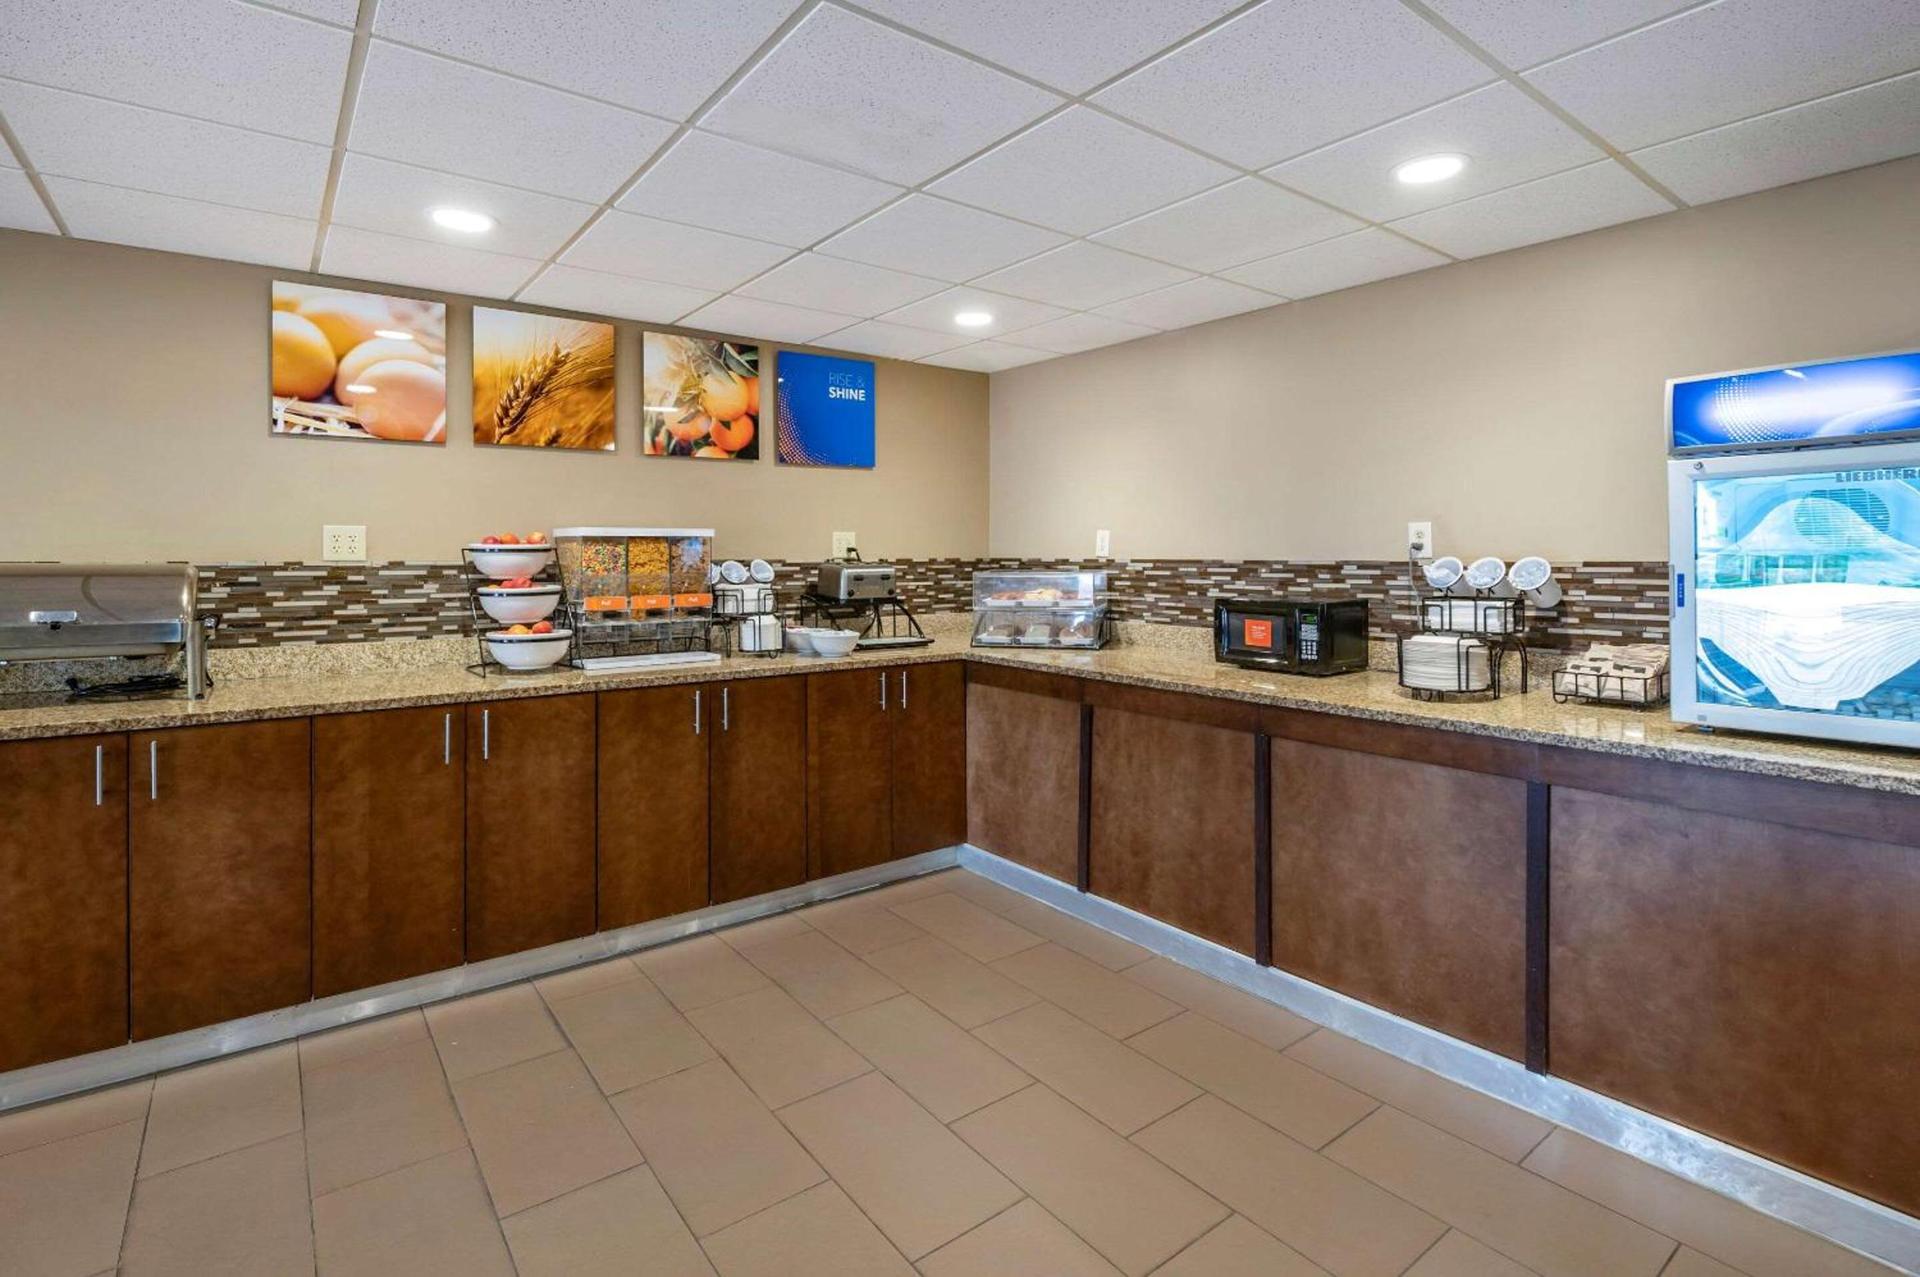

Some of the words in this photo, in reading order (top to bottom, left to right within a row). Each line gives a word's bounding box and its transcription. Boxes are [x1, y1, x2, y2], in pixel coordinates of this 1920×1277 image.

[828, 372, 852, 387] RISE
[828, 386, 866, 401] SHINE
[1836, 469, 1920, 483] LIEBHER
